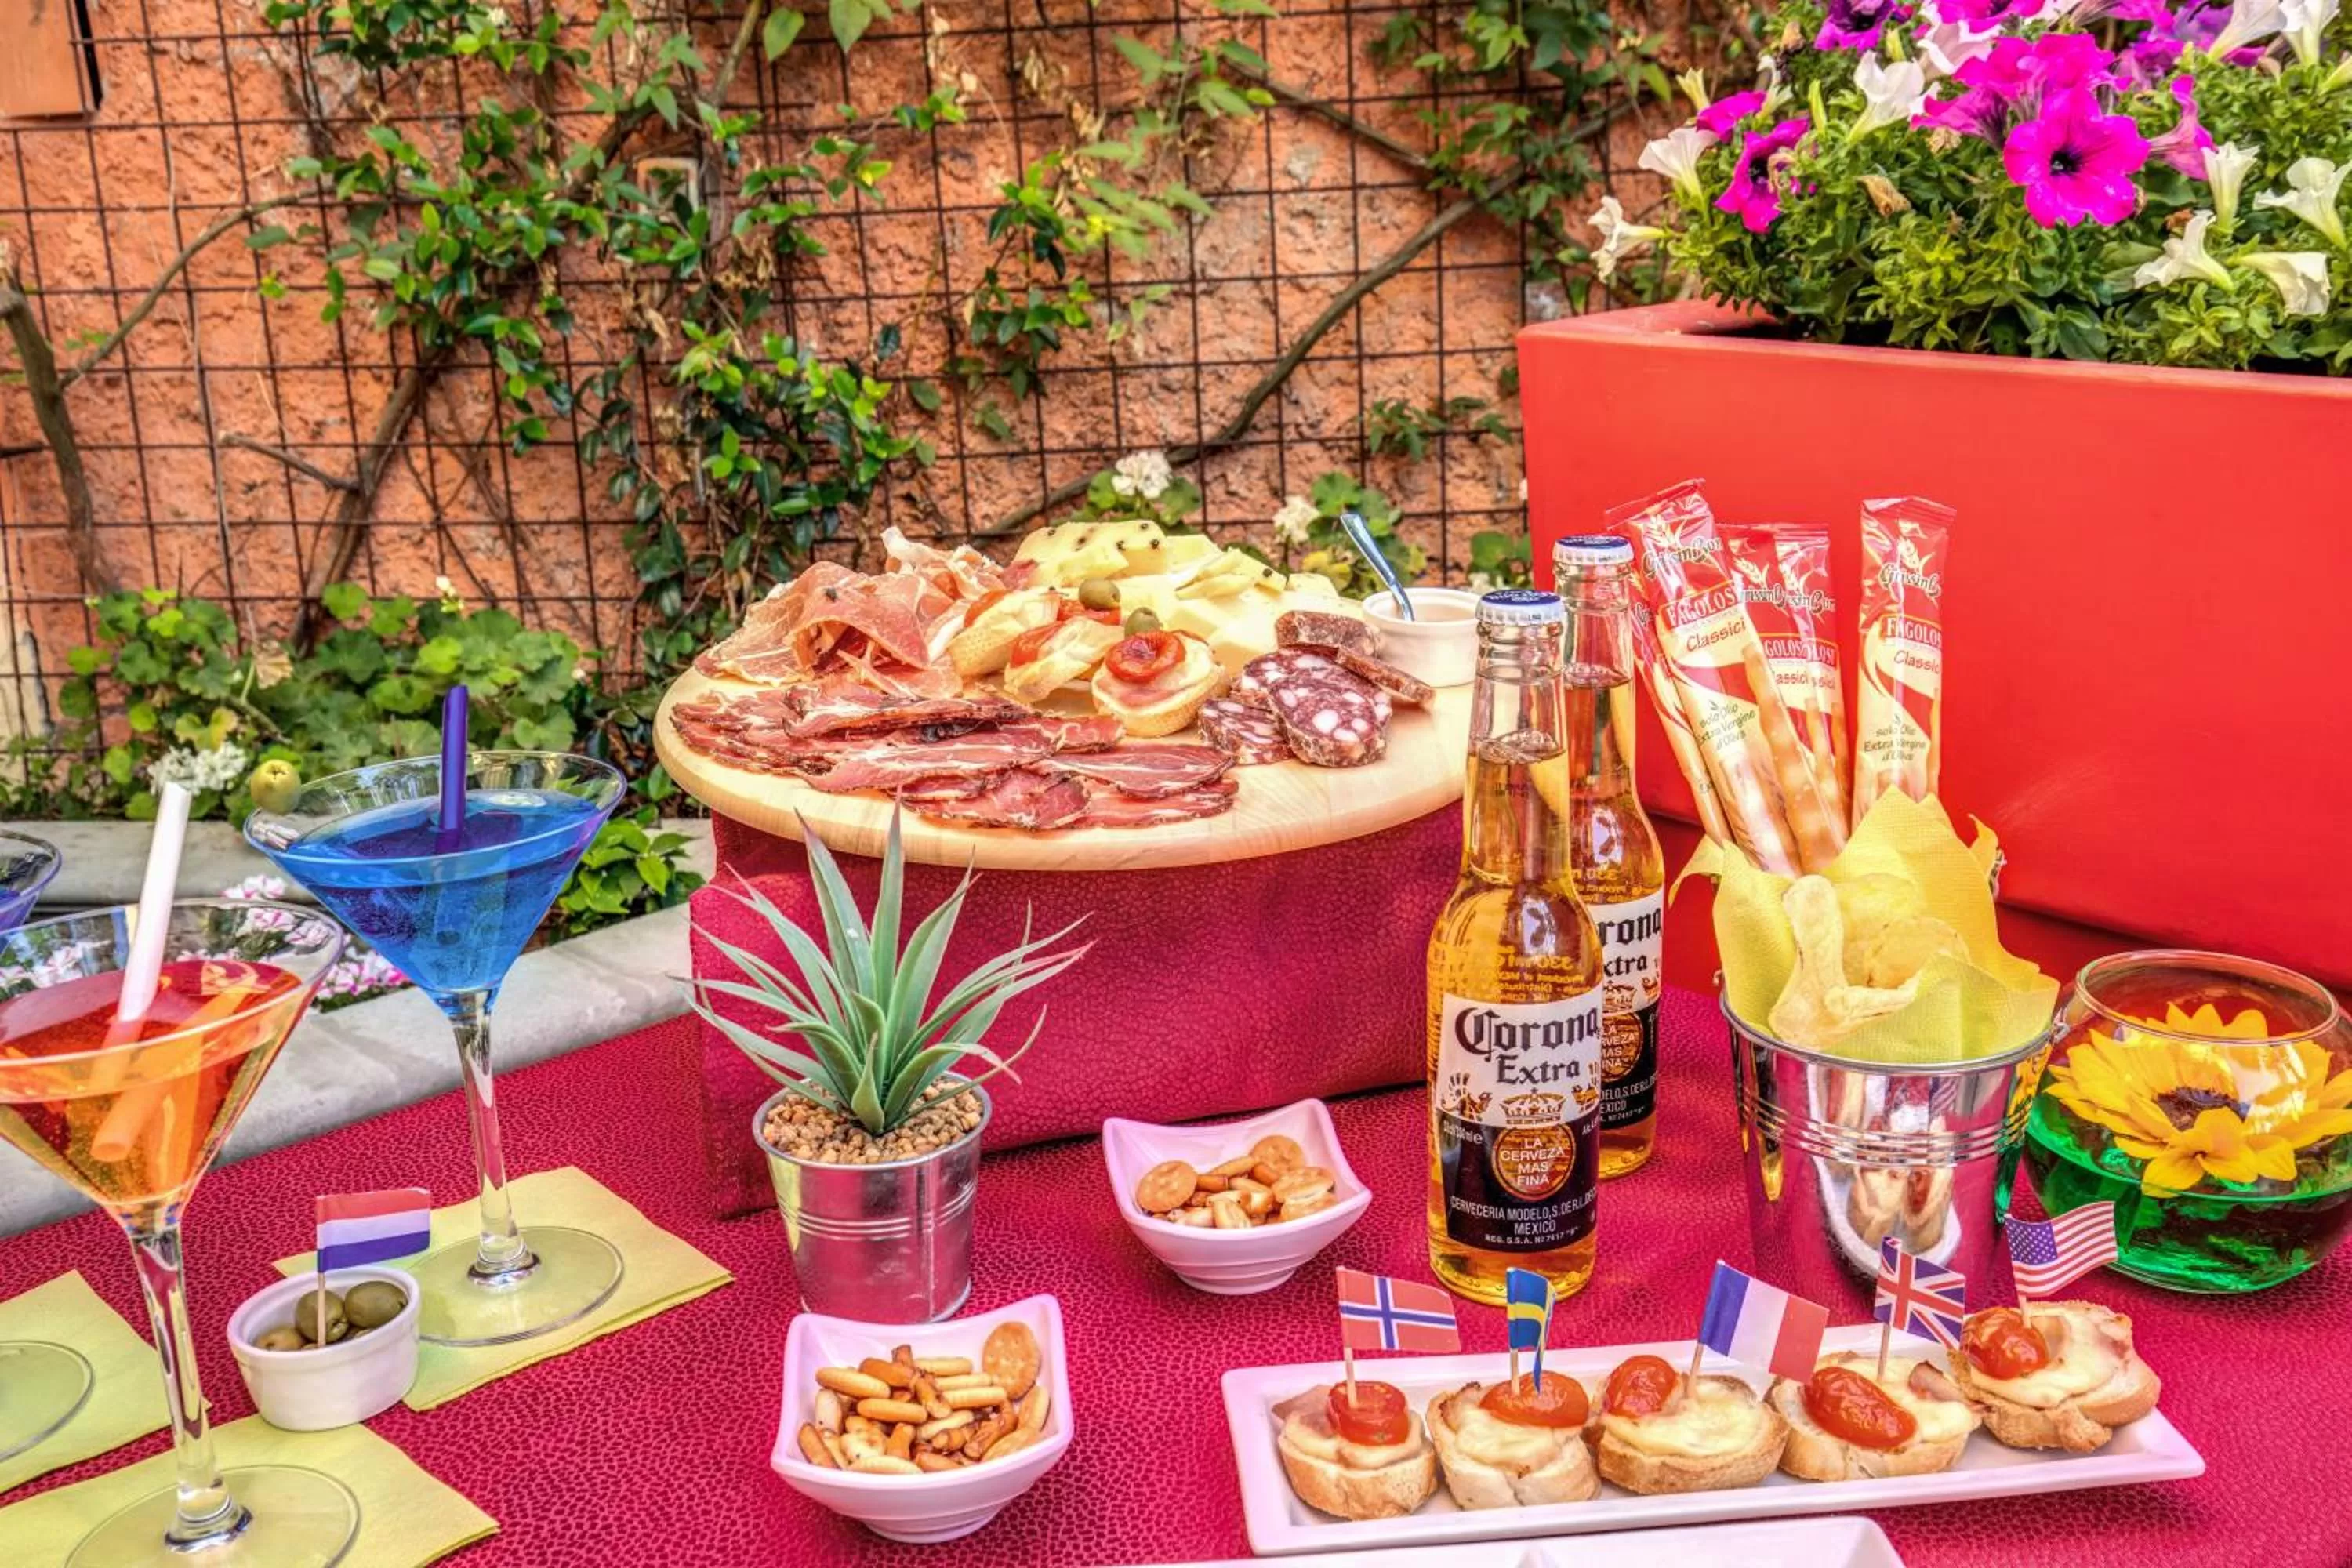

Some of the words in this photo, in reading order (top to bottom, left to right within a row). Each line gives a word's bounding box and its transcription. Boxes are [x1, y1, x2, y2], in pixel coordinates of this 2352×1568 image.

[1686, 616, 1748, 652] Classici
[1597, 907, 1661, 946] rona
[1603, 954, 1648, 977] xtra
[1454, 1007, 1599, 1062] Corona
[1497, 1054, 1581, 1084] Extra
[1602, 1058, 1622, 1069] INA
[1600, 1100, 1627, 1114] EXICO
[1524, 1138, 1543, 1148] LA
[1501, 1147, 1566, 1162] CERVEZA
[1517, 1163, 1550, 1174] MAS
[1517, 1174, 1550, 1186] FINA
[1450, 1196, 1506, 1219] CERVECERIA
[1514, 1220, 1556, 1236] MEXICO
